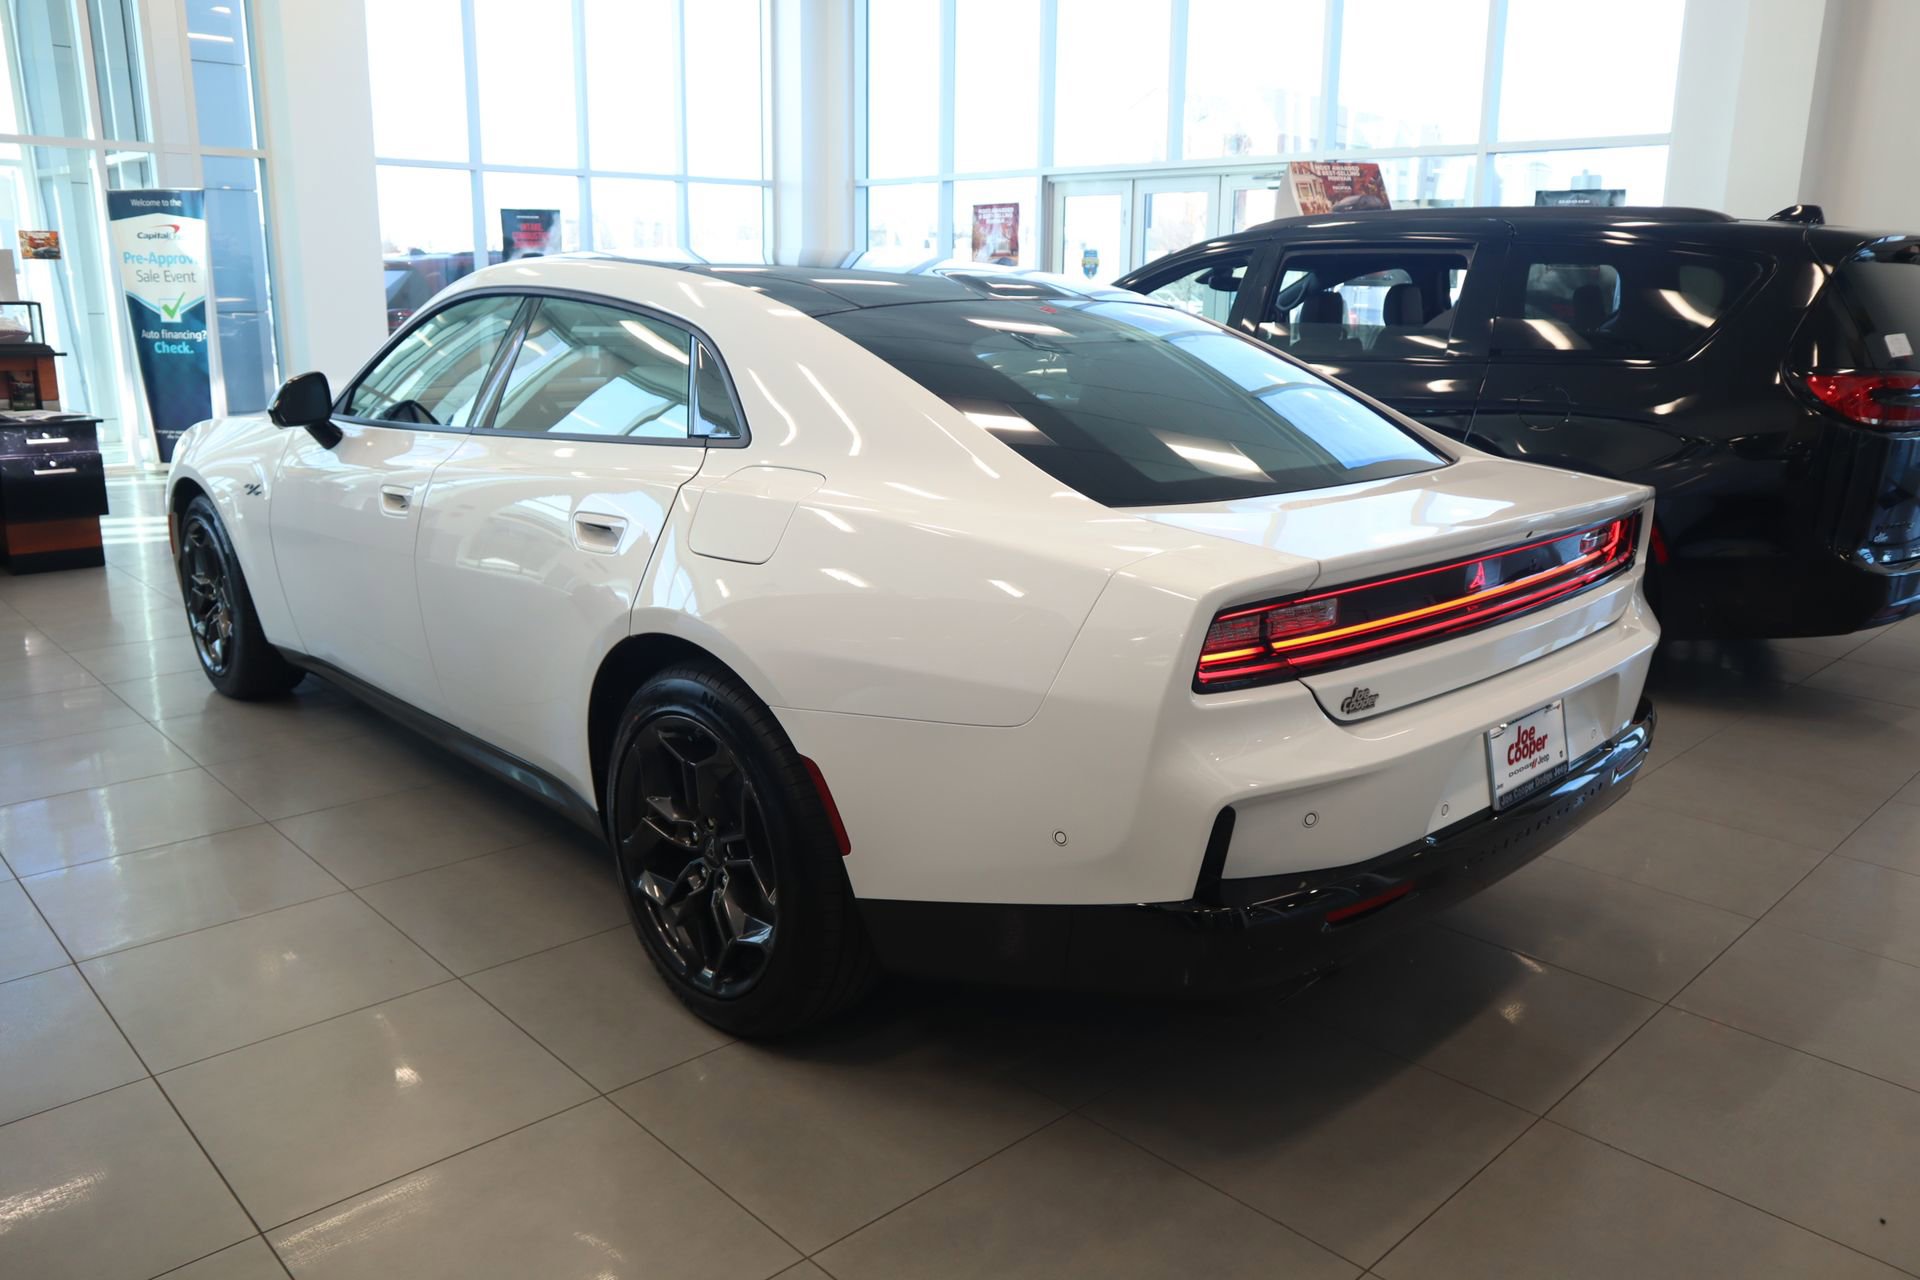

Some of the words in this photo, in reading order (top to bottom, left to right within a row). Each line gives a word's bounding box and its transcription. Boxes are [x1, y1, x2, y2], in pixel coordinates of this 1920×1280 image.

[161, 199, 169, 207] to
[169, 198, 182, 207] the
[123, 251, 198, 267] Pre-Approv
[136, 269, 160, 283] Sale
[163, 269, 196, 283] Event
[141, 329, 160, 339] Auto
[161, 329, 208, 342] financing?
[154, 341, 194, 354] Check.
[1352, 687, 1370, 702] Joe
[1340, 693, 1379, 715] Cooper
[1515, 725, 1536, 748] Joe
[1507, 733, 1548, 766] Cooper
[1537, 753, 1550, 765] Jeep
[1513, 781, 1534, 797] Cooper
